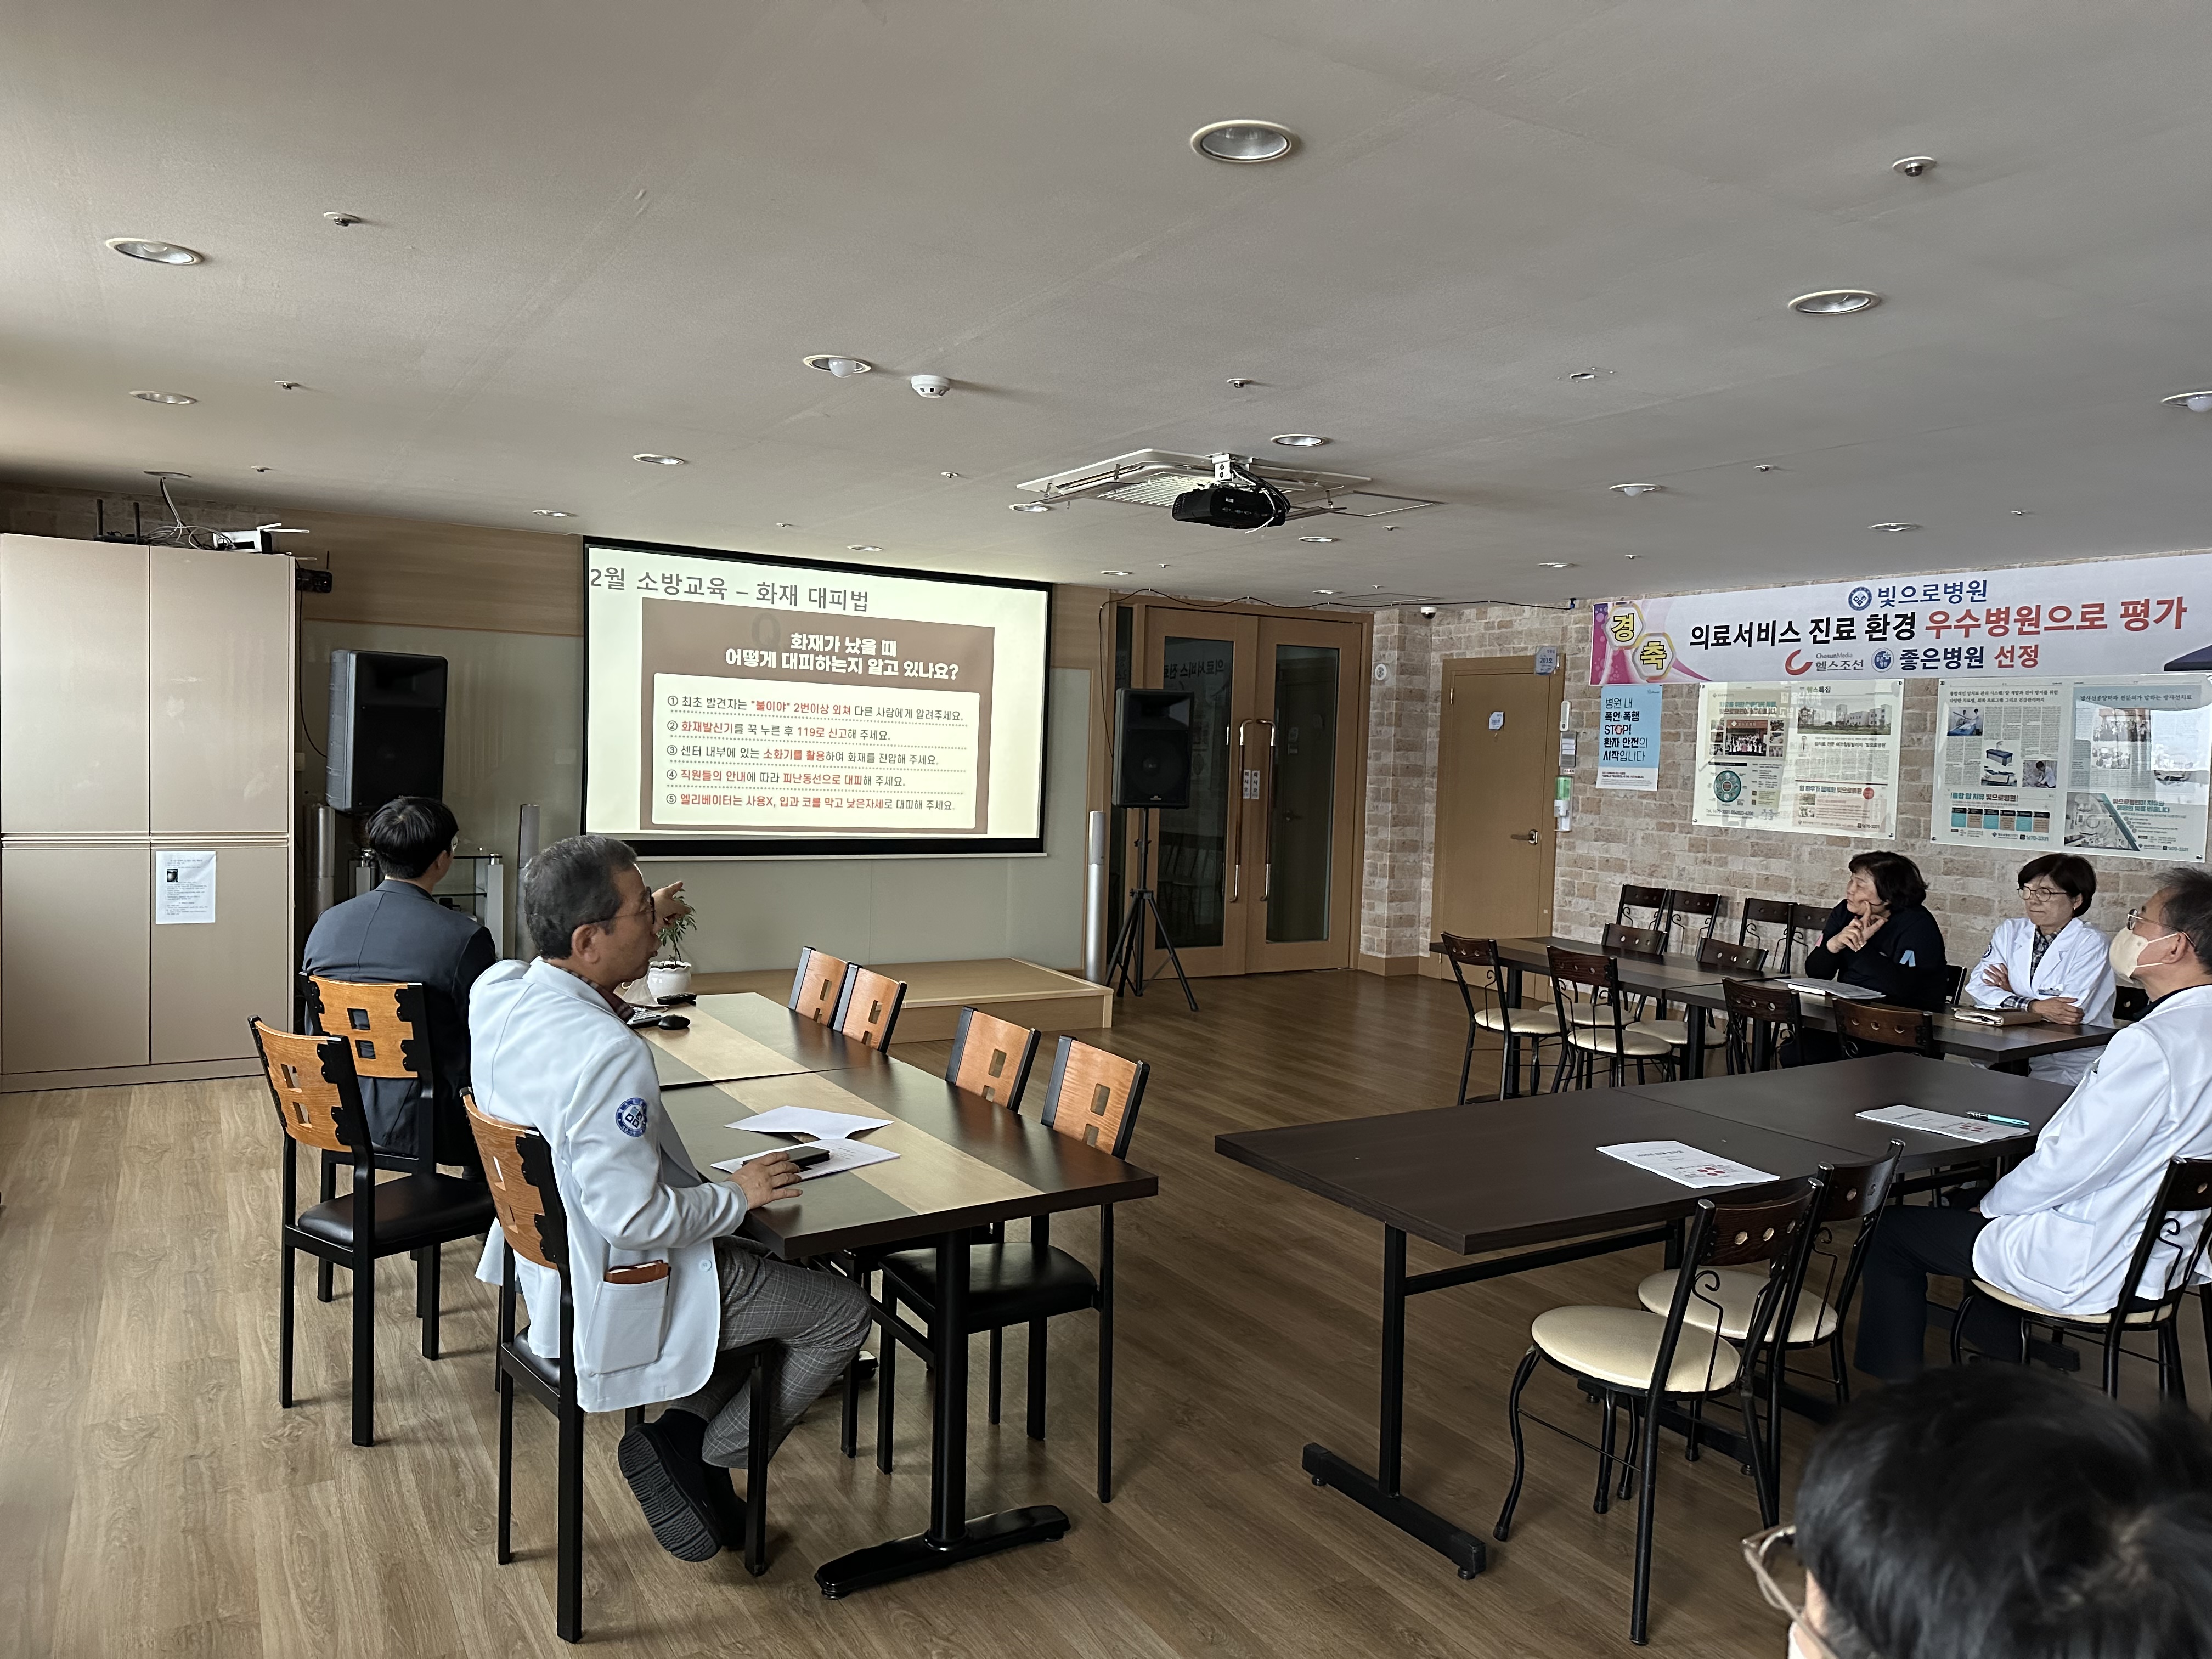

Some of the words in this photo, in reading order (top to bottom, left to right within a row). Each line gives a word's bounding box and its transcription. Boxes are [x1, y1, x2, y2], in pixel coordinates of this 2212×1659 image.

[590, 567, 625, 590] 2월
[637, 572, 727, 600] 소방교육
[756, 582, 797, 607] 화재
[809, 588, 867, 612] 대피법
[1878, 579, 1987, 608] 빛으로병원
[1611, 613, 1635, 642] 경
[1690, 620, 1801, 650] 의료서비스
[1809, 617, 1857, 644] 진료
[1865, 612, 1916, 641] 환경
[1925, 603, 2107, 639] 우수병원으로
[2120, 596, 2187, 631] 평가
[791, 633, 840, 653] 화재가
[845, 637, 877, 656] 났을
[881, 640, 897, 657] 때
[1640, 641, 1667, 670] 축
[725, 648, 776, 668] 어떻게
[782, 652, 862, 674] 대피하는지
[868, 658, 899, 675] 알고
[904, 661, 959, 680] 있나요?
[1815, 659, 1864, 672] 헬스조선
[1899, 646, 1984, 671] 좋은병원
[1994, 644, 2039, 668] 선정
[682, 696, 702, 707] 최초
[706, 697, 747, 710] 발견자는
[794, 703, 829, 714] 2번이상
[833, 704, 851, 715] 외쳐
[855, 706, 872, 716] 다른
[876, 707, 912, 719] 사람에게
[916, 709, 963, 721] 알려주세요.
[1605, 698, 1622, 709] 병원
[1624, 697, 1633, 708] 내
[681, 721, 743, 734] 화재발신기를
[761, 725, 780, 736] 누른
[784, 726, 793, 736] 후
[797, 727, 825, 737] 119로
[828, 728, 856, 739] 신고해
[860, 729, 890, 740] 주세요.
[1604, 737, 1620, 748] 환자
[1622, 737, 1647, 748] 안전의
[681, 746, 701, 757] 센터
[706, 746, 736, 758] 내부에
[740, 747, 759, 759] 있는
[763, 749, 802, 760] 소화기를
[806, 750, 844, 761] 활용하여
[848, 752, 875, 763] 화재를
[879, 753, 905, 764] 진압해
[909, 754, 939, 765] 주세요.
[1602, 751, 1645, 761] 시작입니다
[681, 769, 721, 781] 직원들의
[726, 771, 755, 782] 안내에
[760, 772, 780, 783] 따라
[783, 773, 840, 785] 피난동선으로
[844, 775, 871, 786] 대피해
[876, 776, 905, 786] 주세요.
[681, 794, 742, 806] 엘리베이터는
[746, 795, 776, 808] 사용X,
[780, 797, 799, 807] 입과
[802, 797, 821, 808] 코를
[825, 798, 843, 808] 막고
[847, 798, 893, 809] 낮은자세로
[896, 799, 922, 810] 대피해
[926, 800, 955, 810] 주세요.
